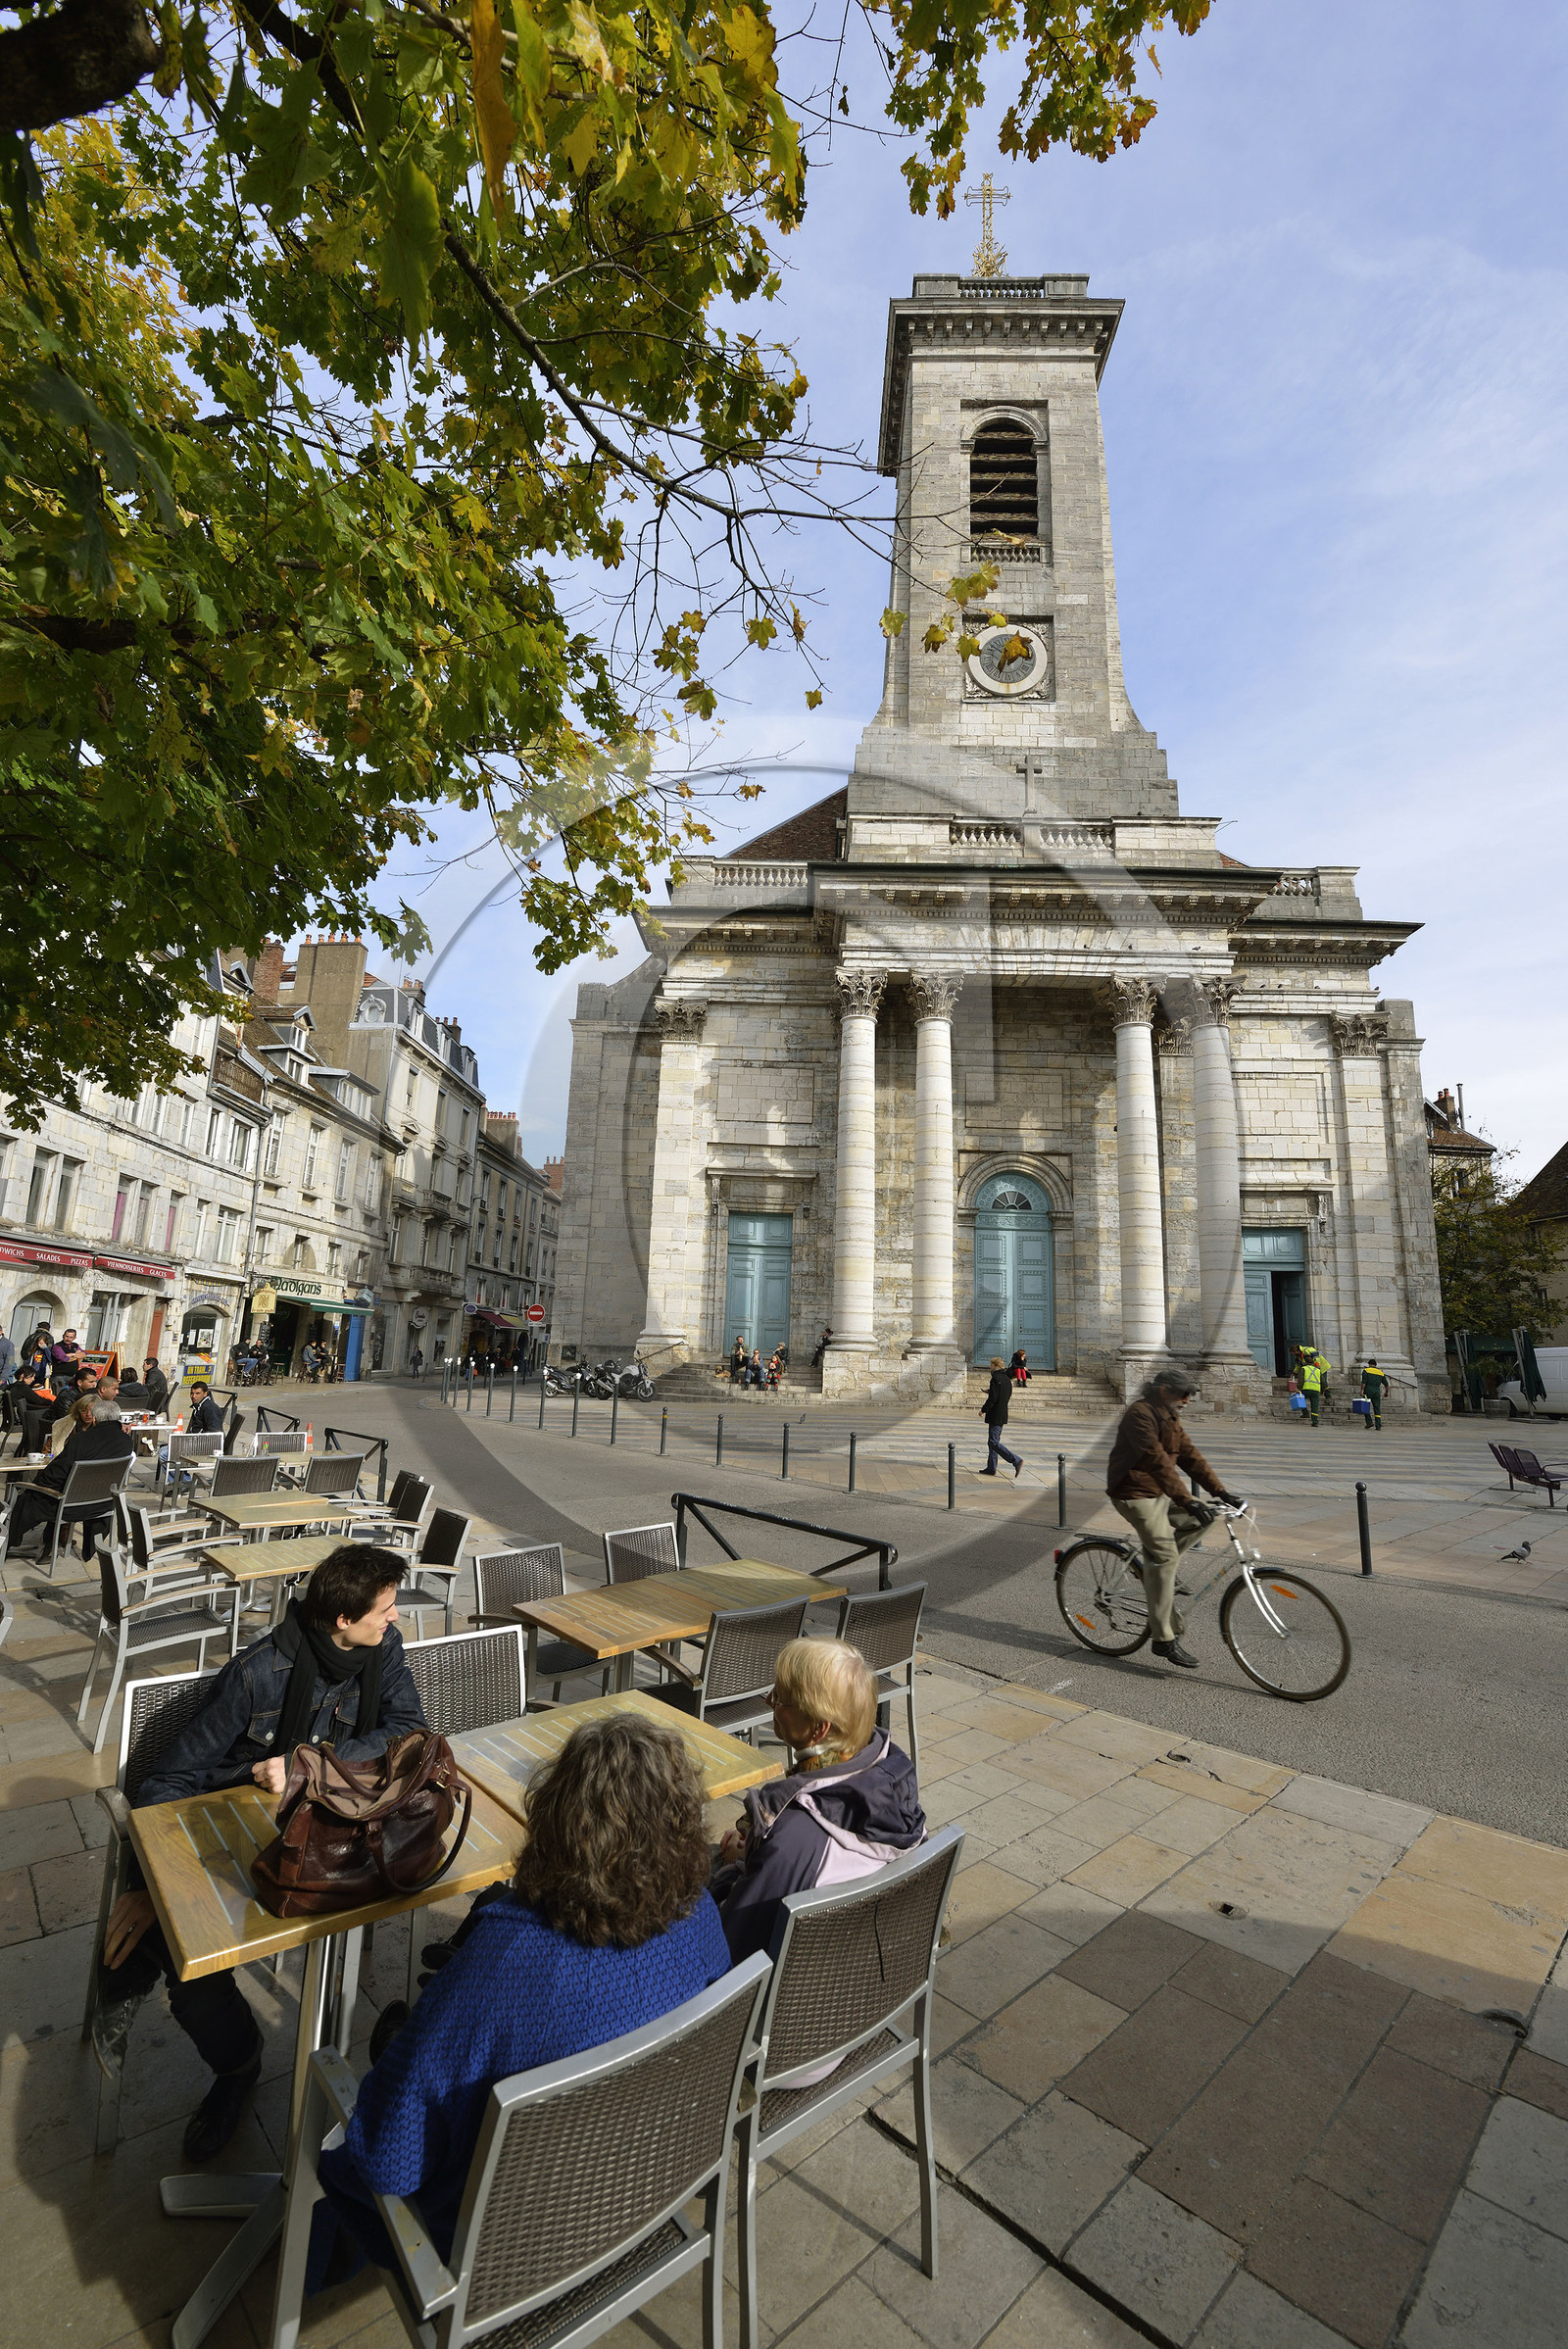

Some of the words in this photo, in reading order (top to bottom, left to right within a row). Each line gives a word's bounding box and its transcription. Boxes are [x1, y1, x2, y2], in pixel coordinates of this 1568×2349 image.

[36, 1252, 61, 1262] SALADES
[107, 1260, 144, 1273] VIENNOISERIES
[149, 1269, 168, 1278] GLACES
